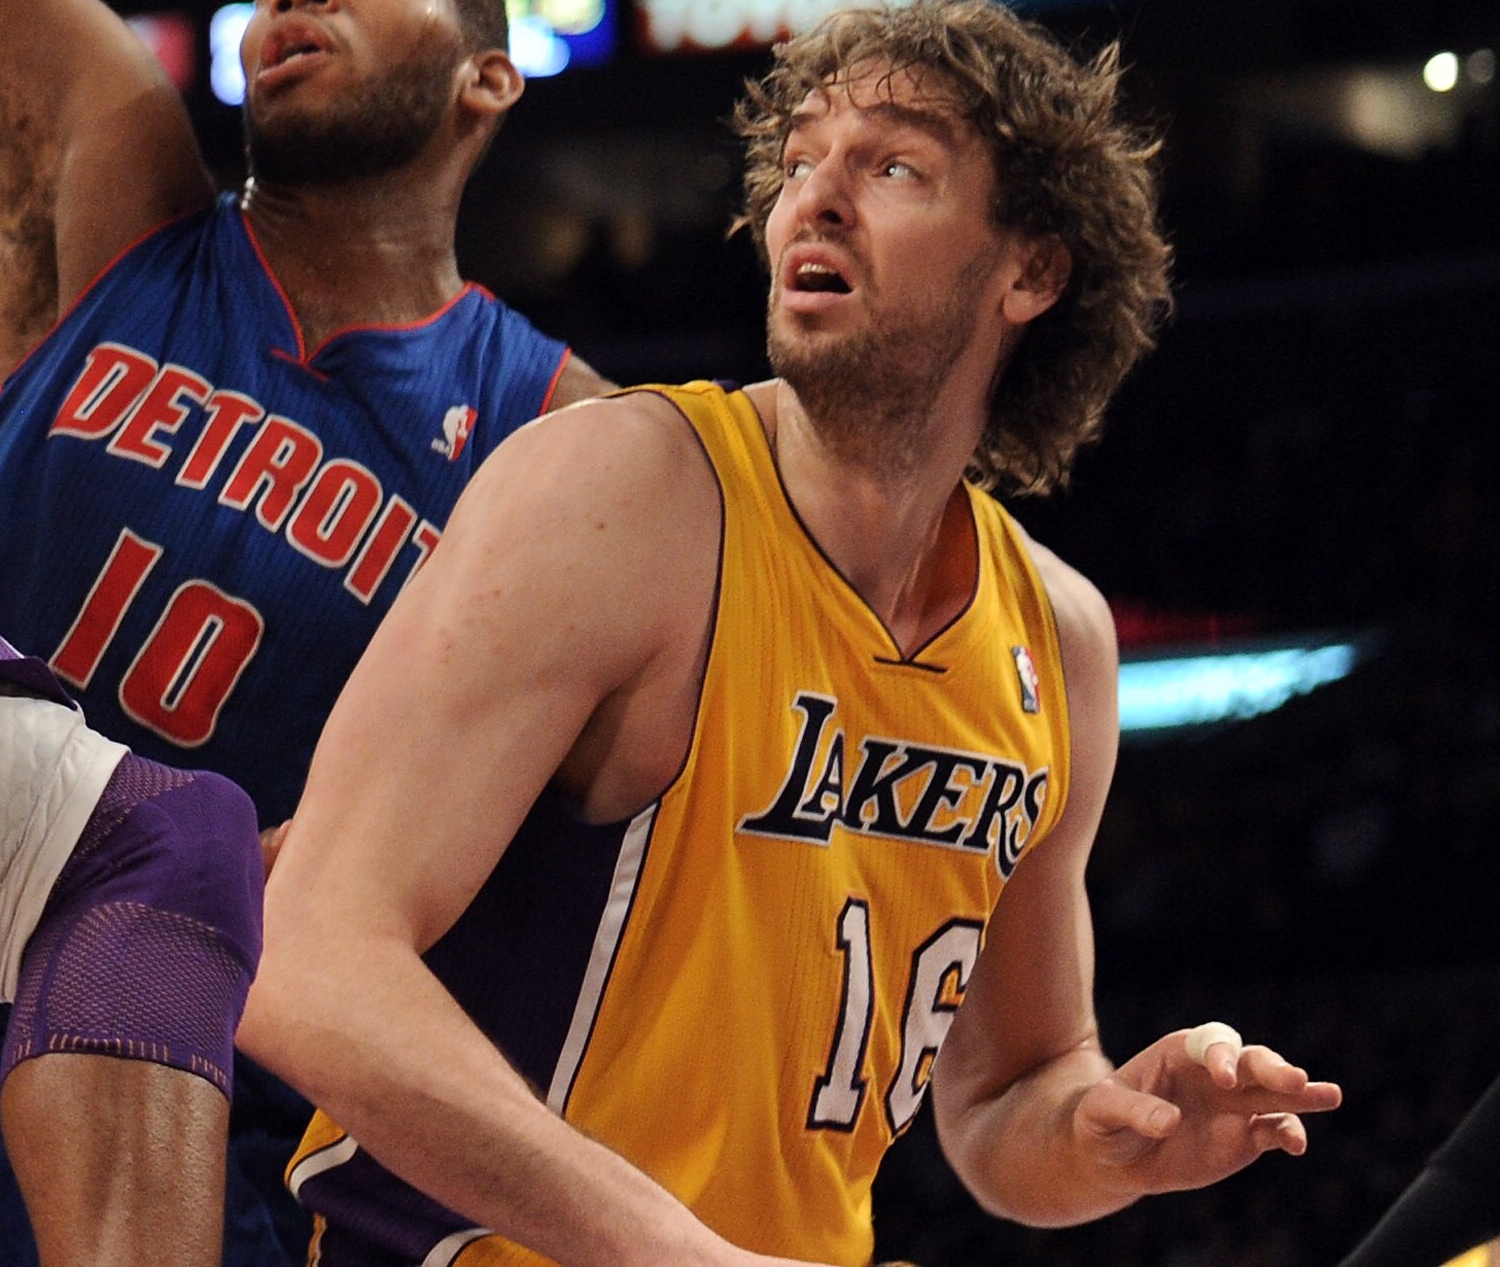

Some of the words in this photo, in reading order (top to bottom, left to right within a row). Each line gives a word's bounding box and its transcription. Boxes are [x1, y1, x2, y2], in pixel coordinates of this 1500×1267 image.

[49, 527, 265, 749] 10
[735, 690, 1050, 883] LAKERS
[804, 896, 986, 1139] 16
